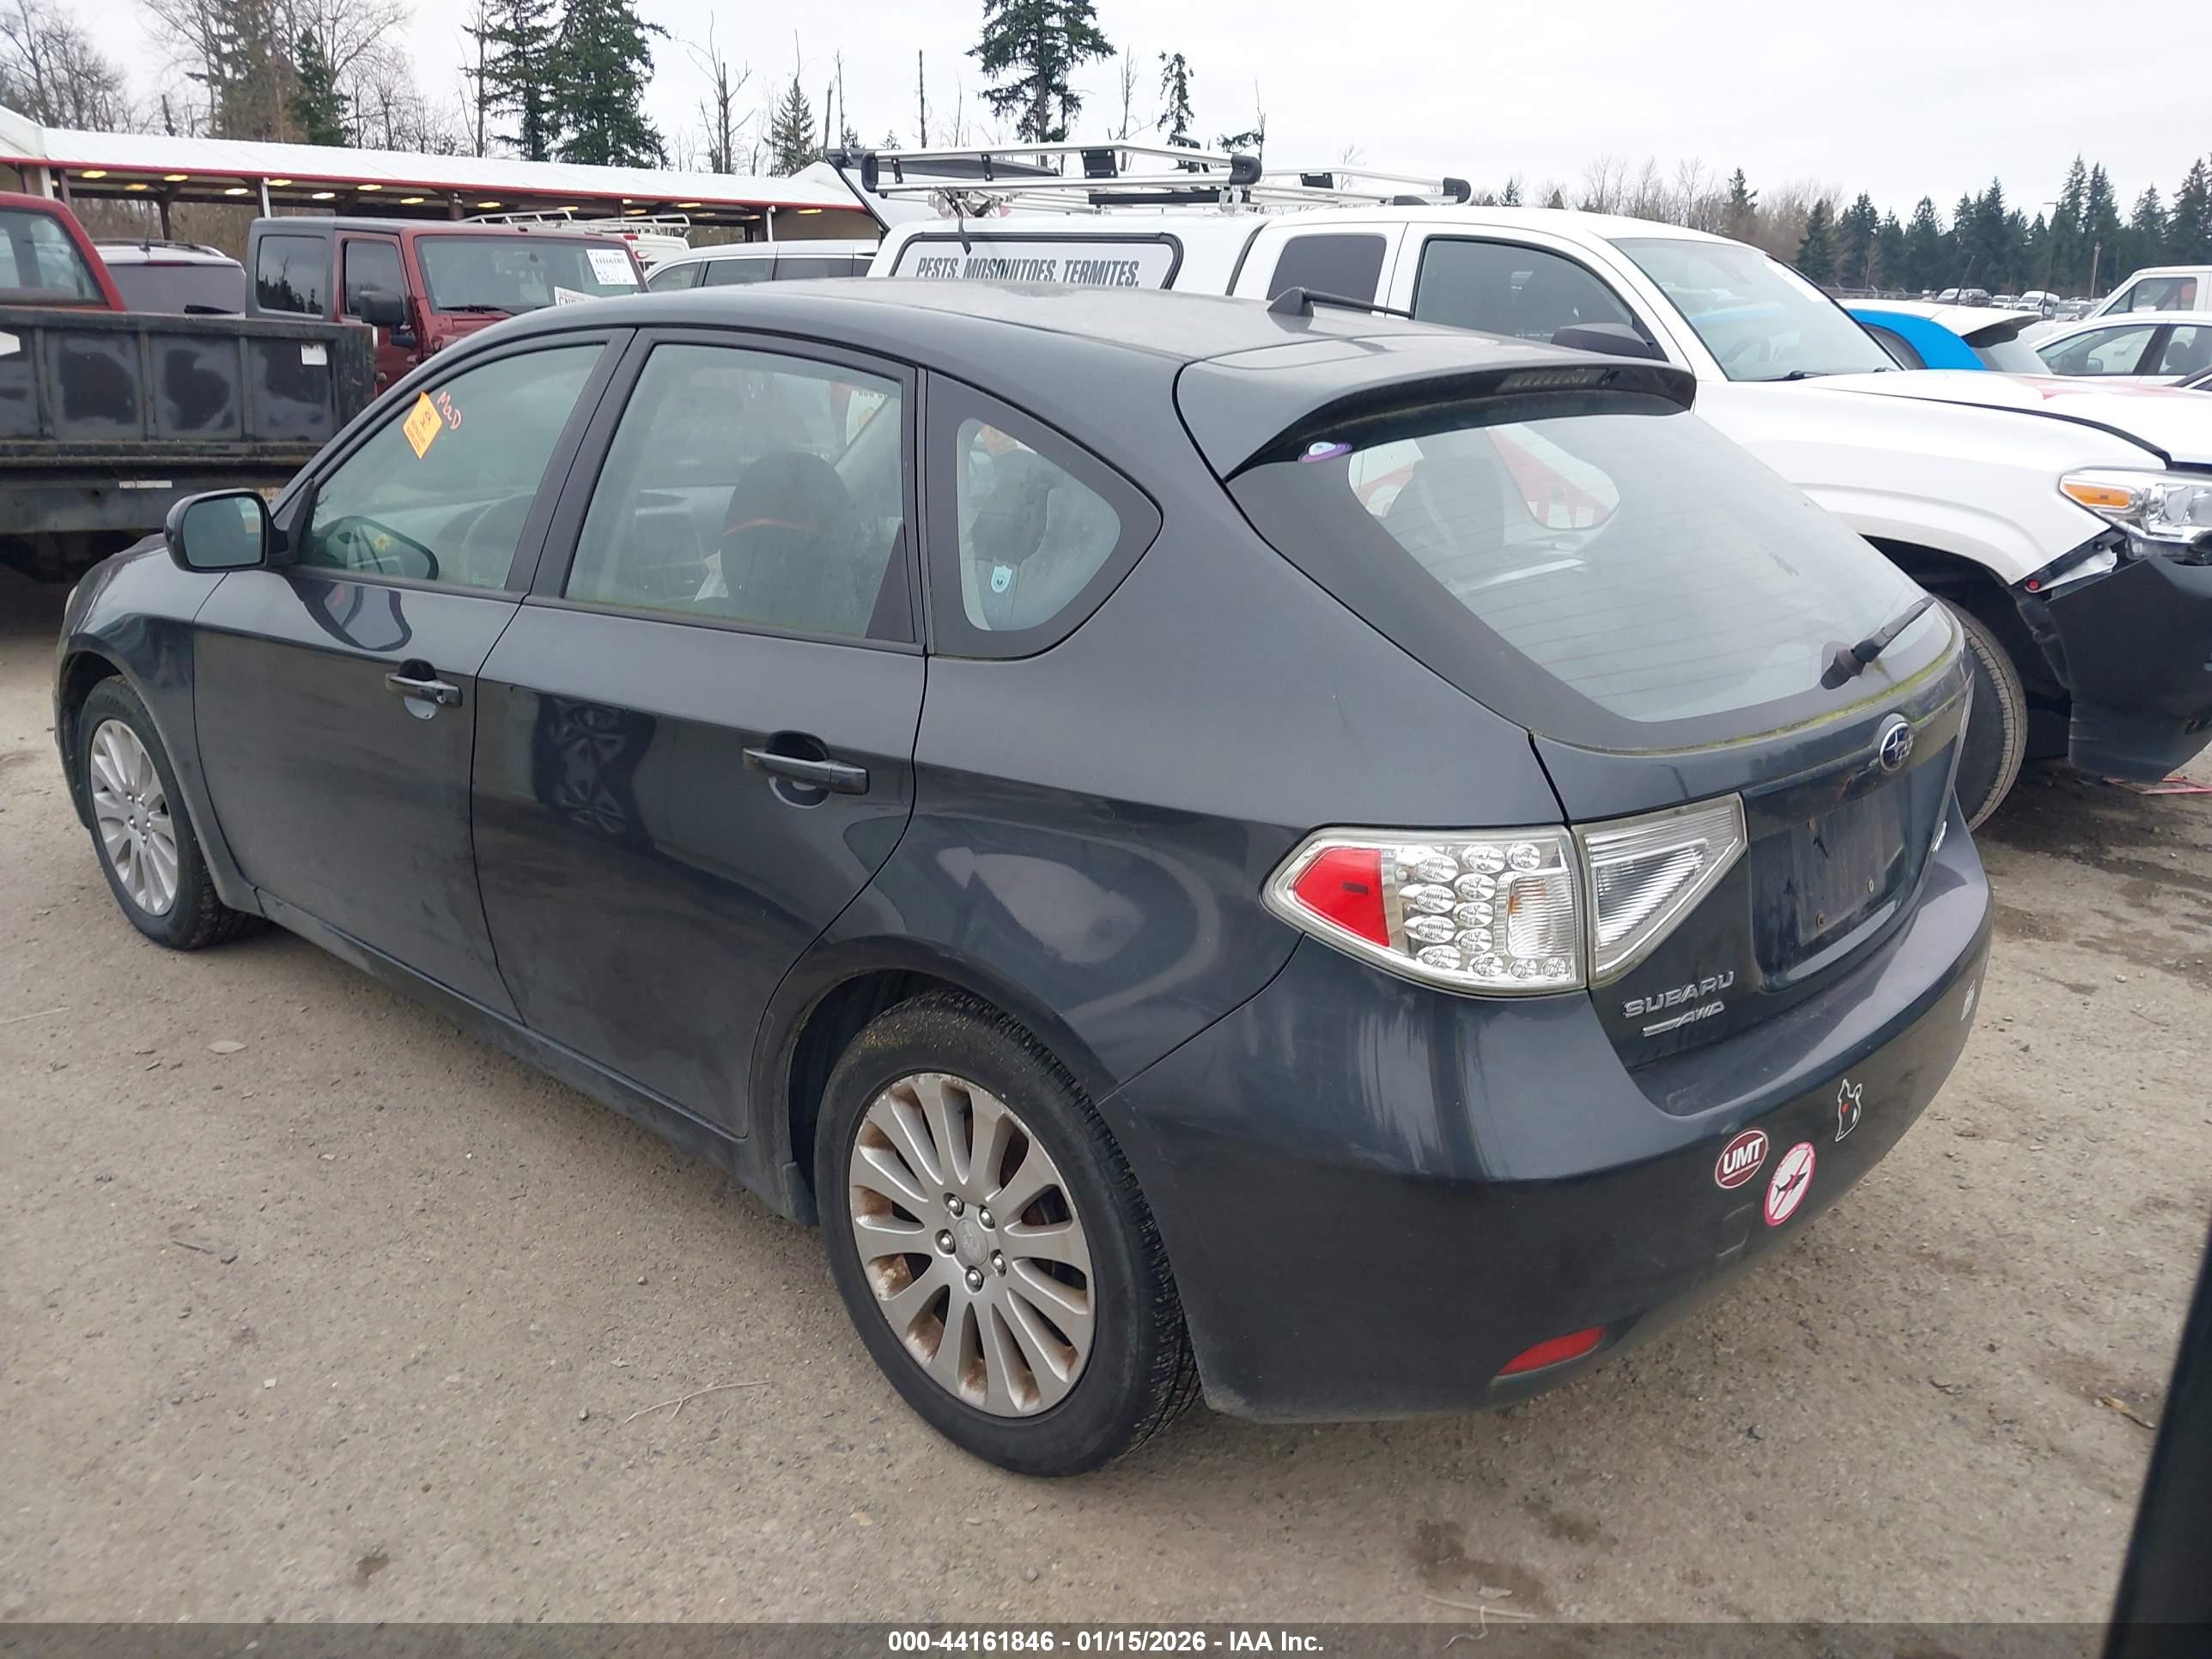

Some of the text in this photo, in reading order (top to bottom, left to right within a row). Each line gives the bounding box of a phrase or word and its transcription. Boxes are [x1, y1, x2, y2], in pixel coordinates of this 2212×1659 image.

[915, 257, 1140, 288] PESTS. MOSQUITOES. TERMITES.
[1622, 970, 1735, 1019] SUBARU
[1674, 1000, 1725, 1029] AWD
[1723, 1137, 1764, 1175] UMT
